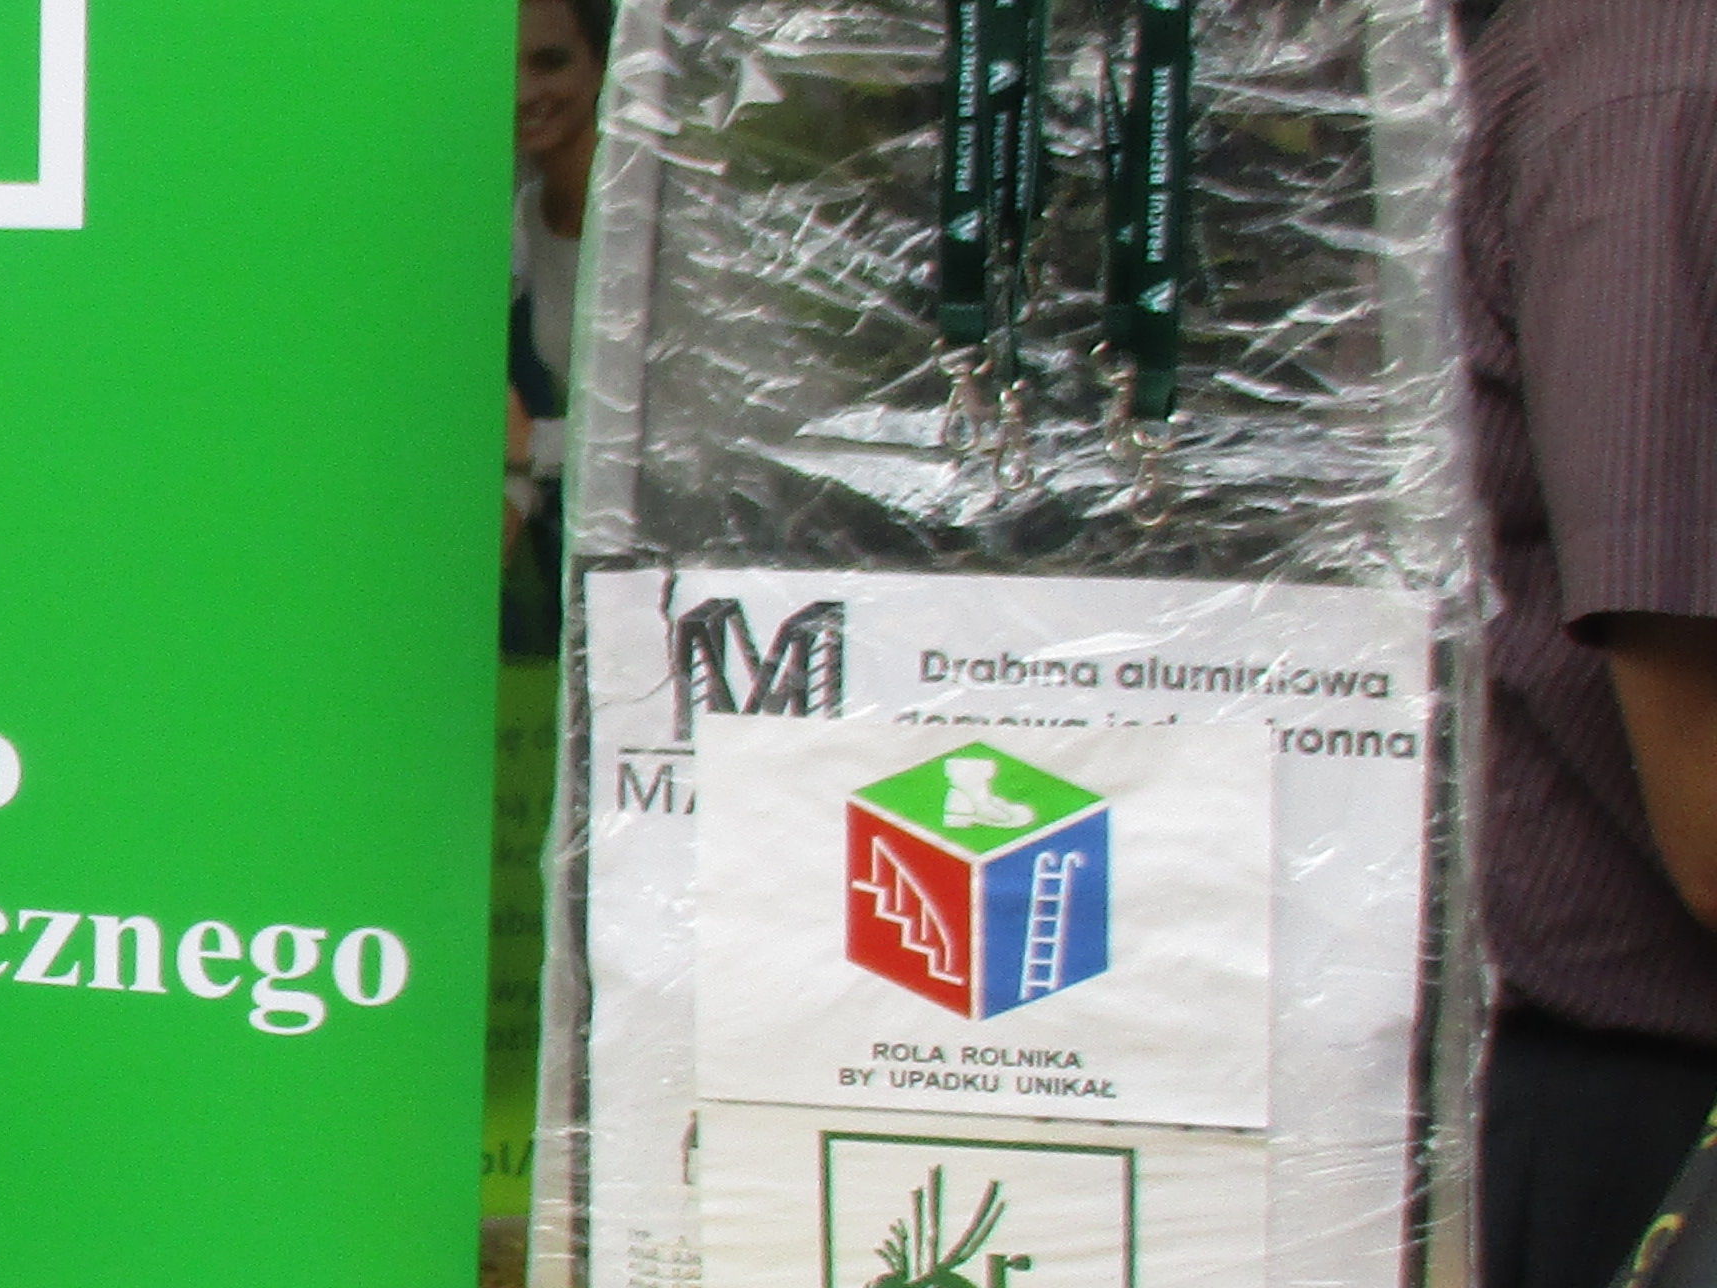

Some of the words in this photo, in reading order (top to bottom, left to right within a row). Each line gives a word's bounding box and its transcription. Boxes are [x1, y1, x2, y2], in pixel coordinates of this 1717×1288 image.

[871, 1042, 946, 1064] ROLA
[961, 1045, 1083, 1070] ROLNIKA
[838, 1066, 876, 1087] BY
[889, 1069, 1000, 1094] UPADKU
[1016, 1075, 1118, 1100] UNIKAŁ
